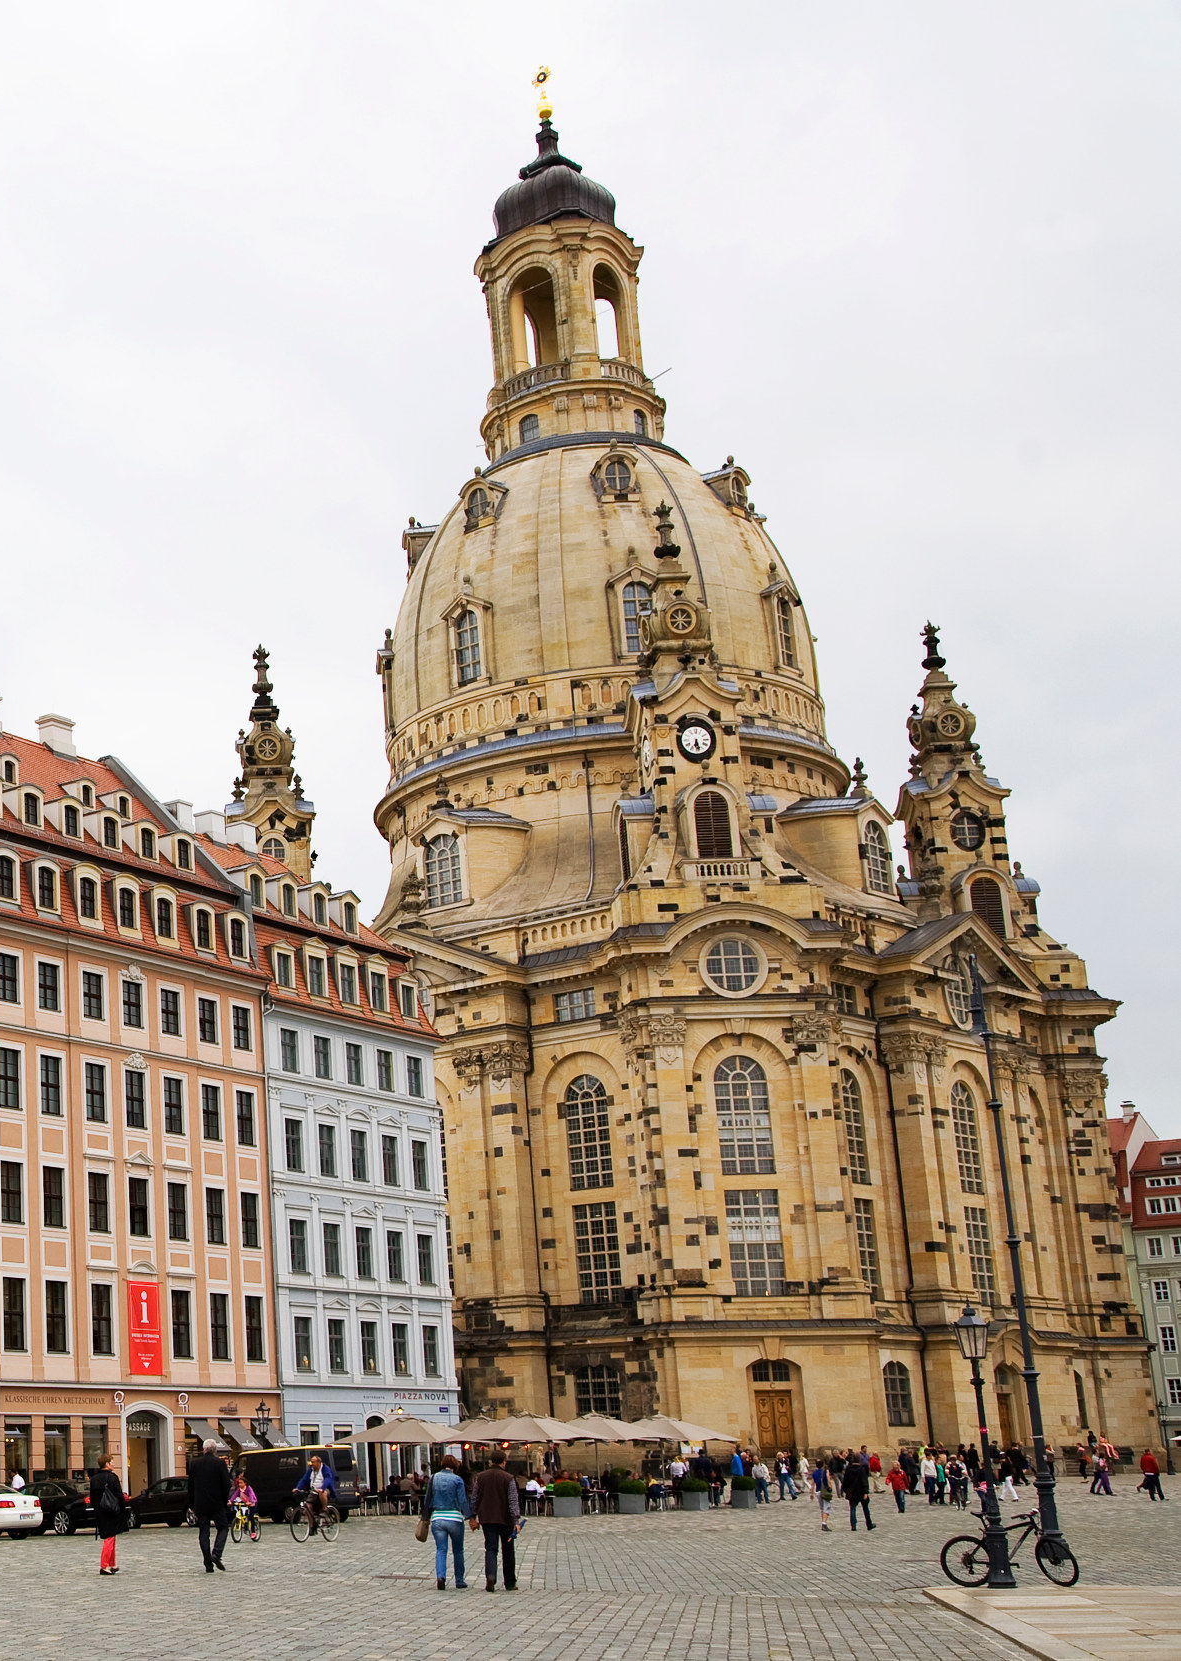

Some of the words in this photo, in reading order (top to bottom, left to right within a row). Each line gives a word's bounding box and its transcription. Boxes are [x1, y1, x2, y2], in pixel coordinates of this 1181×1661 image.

[5, 1395, 40, 1404] KLASSISCHE
[42, 1396, 62, 1404] UHREN
[63, 1396, 106, 1405] KRETZSCHMAR
[394, 1392, 423, 1400] PIAZZA
[424, 1393, 447, 1401] NOVA
